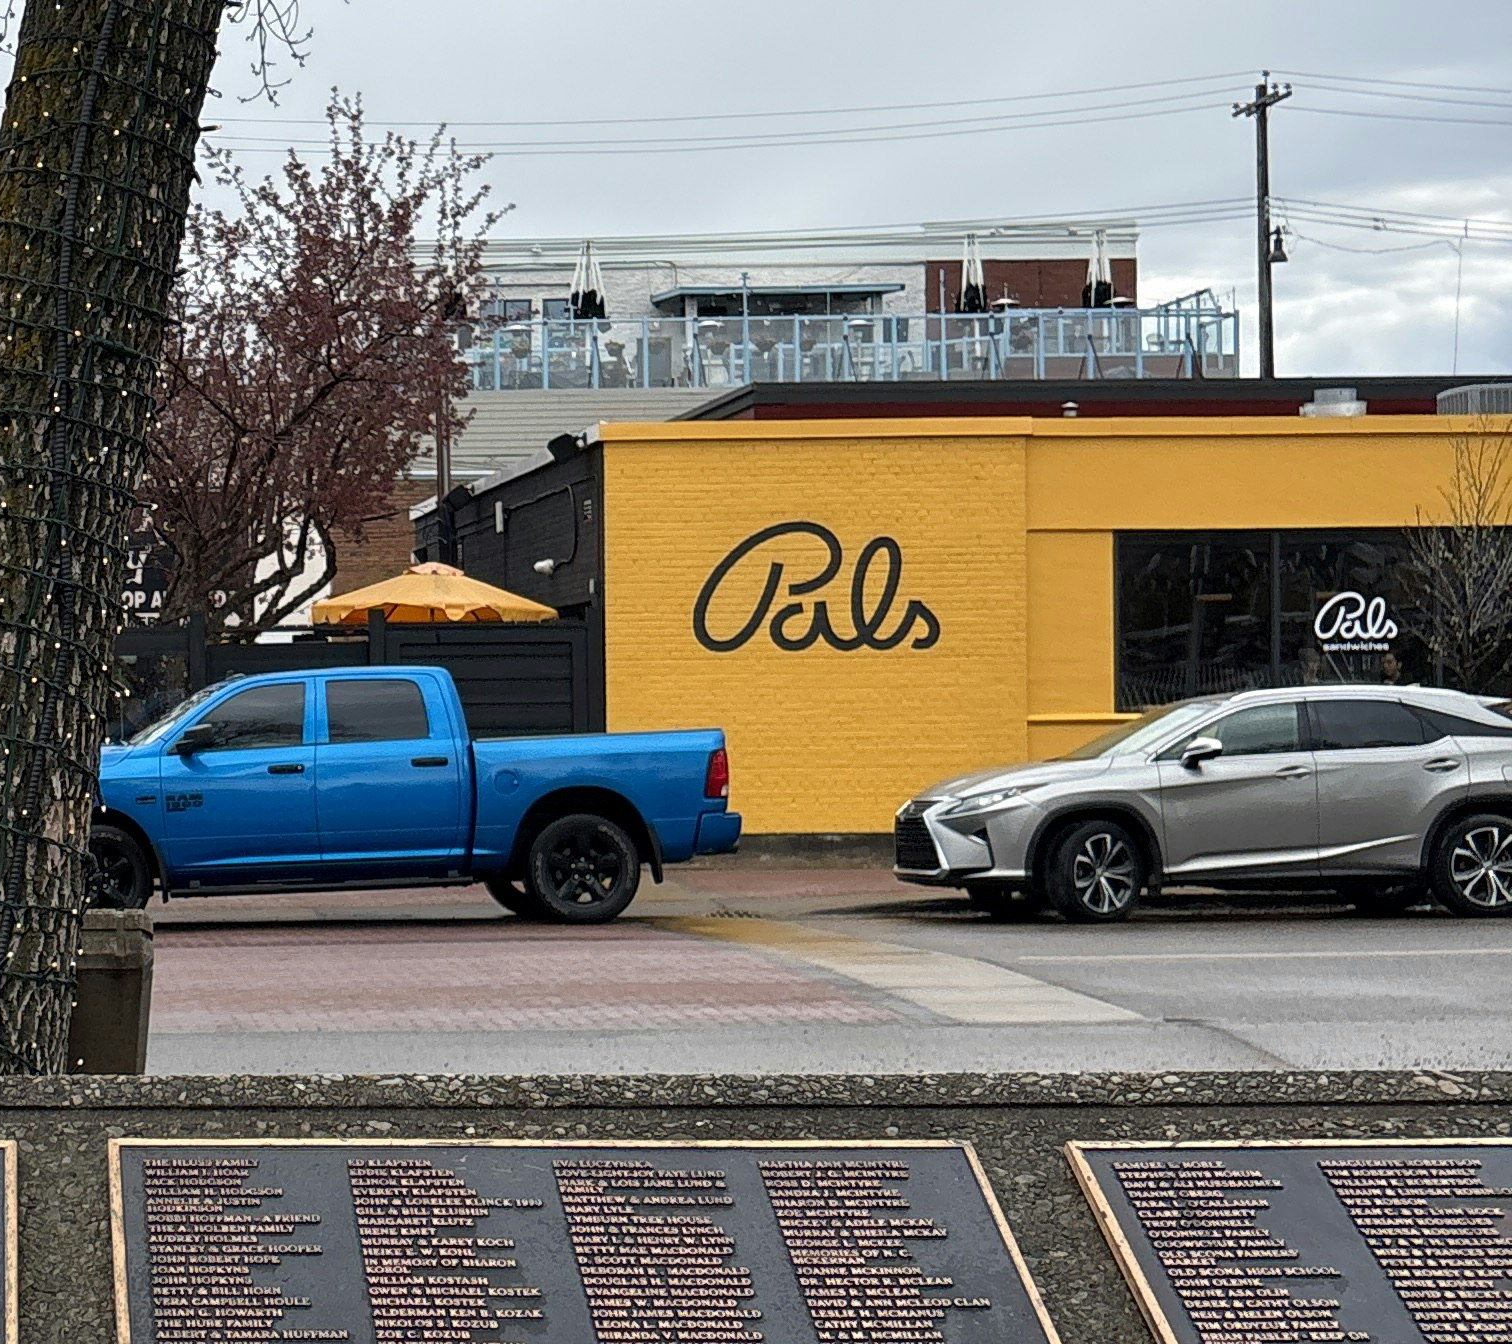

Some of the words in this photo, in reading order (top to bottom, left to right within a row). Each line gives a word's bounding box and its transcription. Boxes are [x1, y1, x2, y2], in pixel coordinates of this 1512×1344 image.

[693, 521, 940, 652] Pals
[1315, 591, 1398, 640] Pals
[1322, 642, 1390, 652] sandwiches
